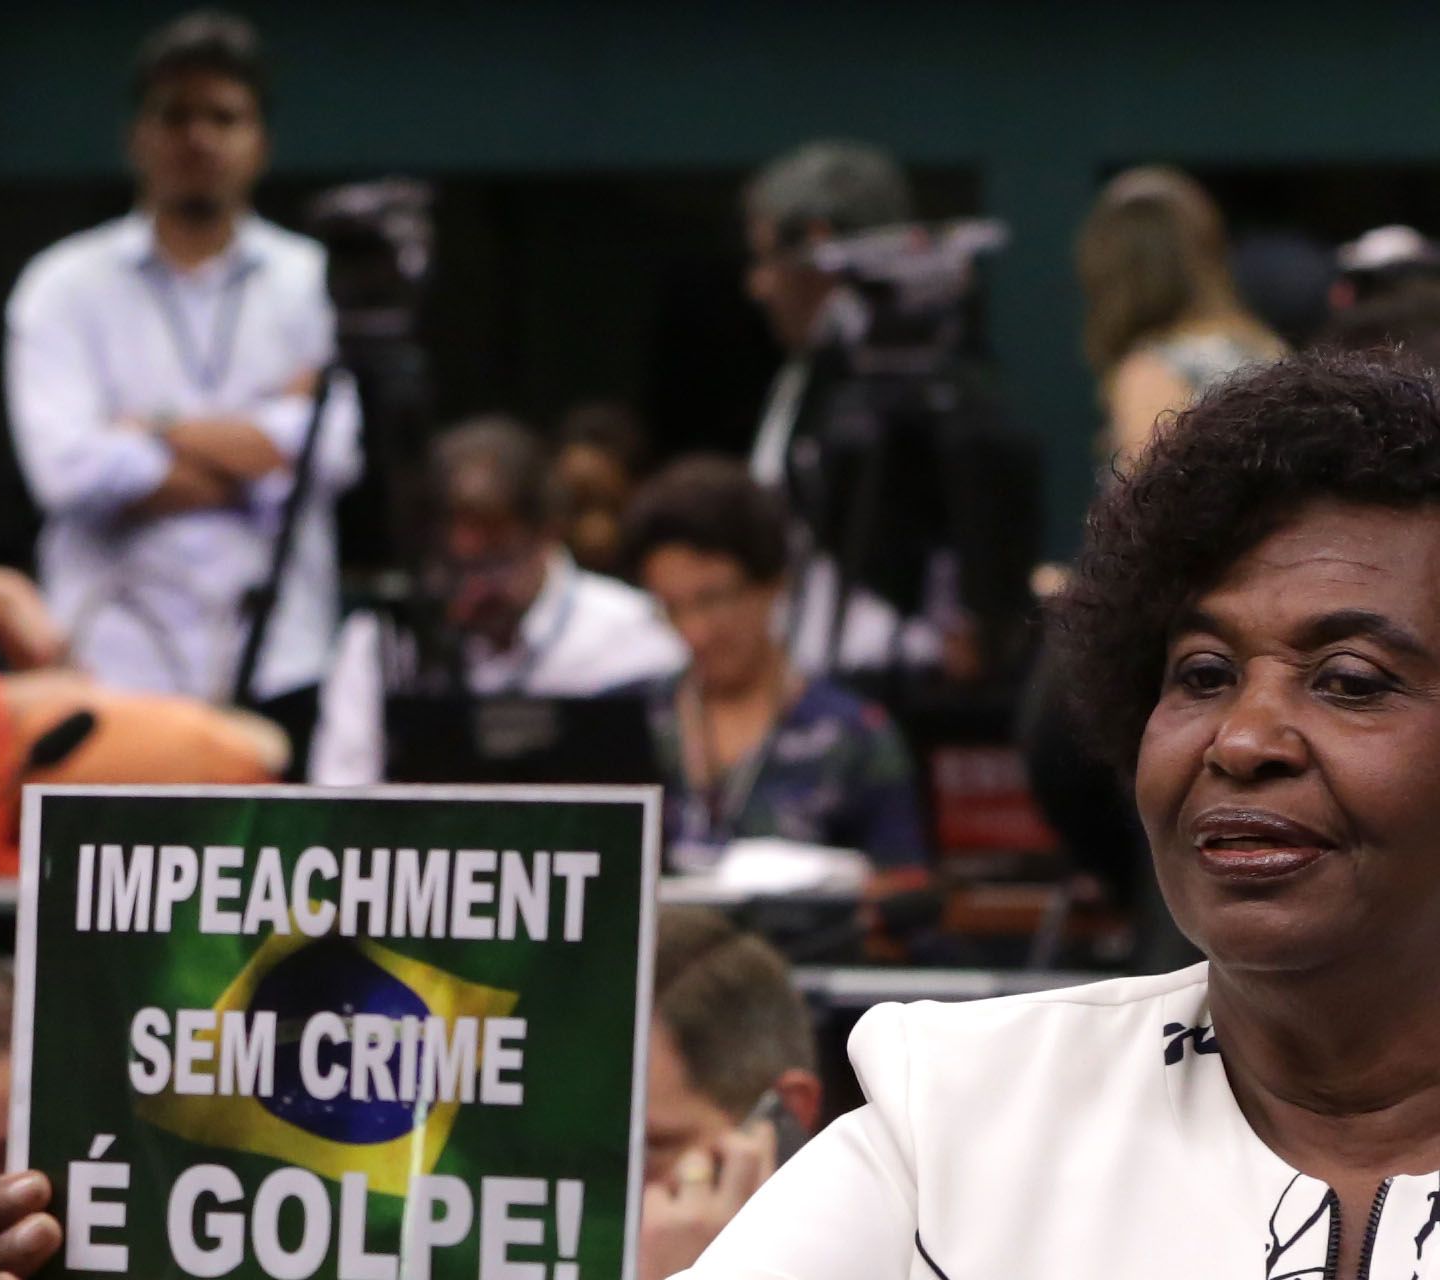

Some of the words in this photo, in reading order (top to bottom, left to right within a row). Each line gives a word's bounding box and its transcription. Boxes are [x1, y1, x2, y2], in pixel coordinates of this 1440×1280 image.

[75, 844, 600, 942] IMPEACHMENT
[128, 1006, 278, 1098] SEM
[299, 1011, 527, 1105] CRIME
[65, 1134, 130, 1272] É
